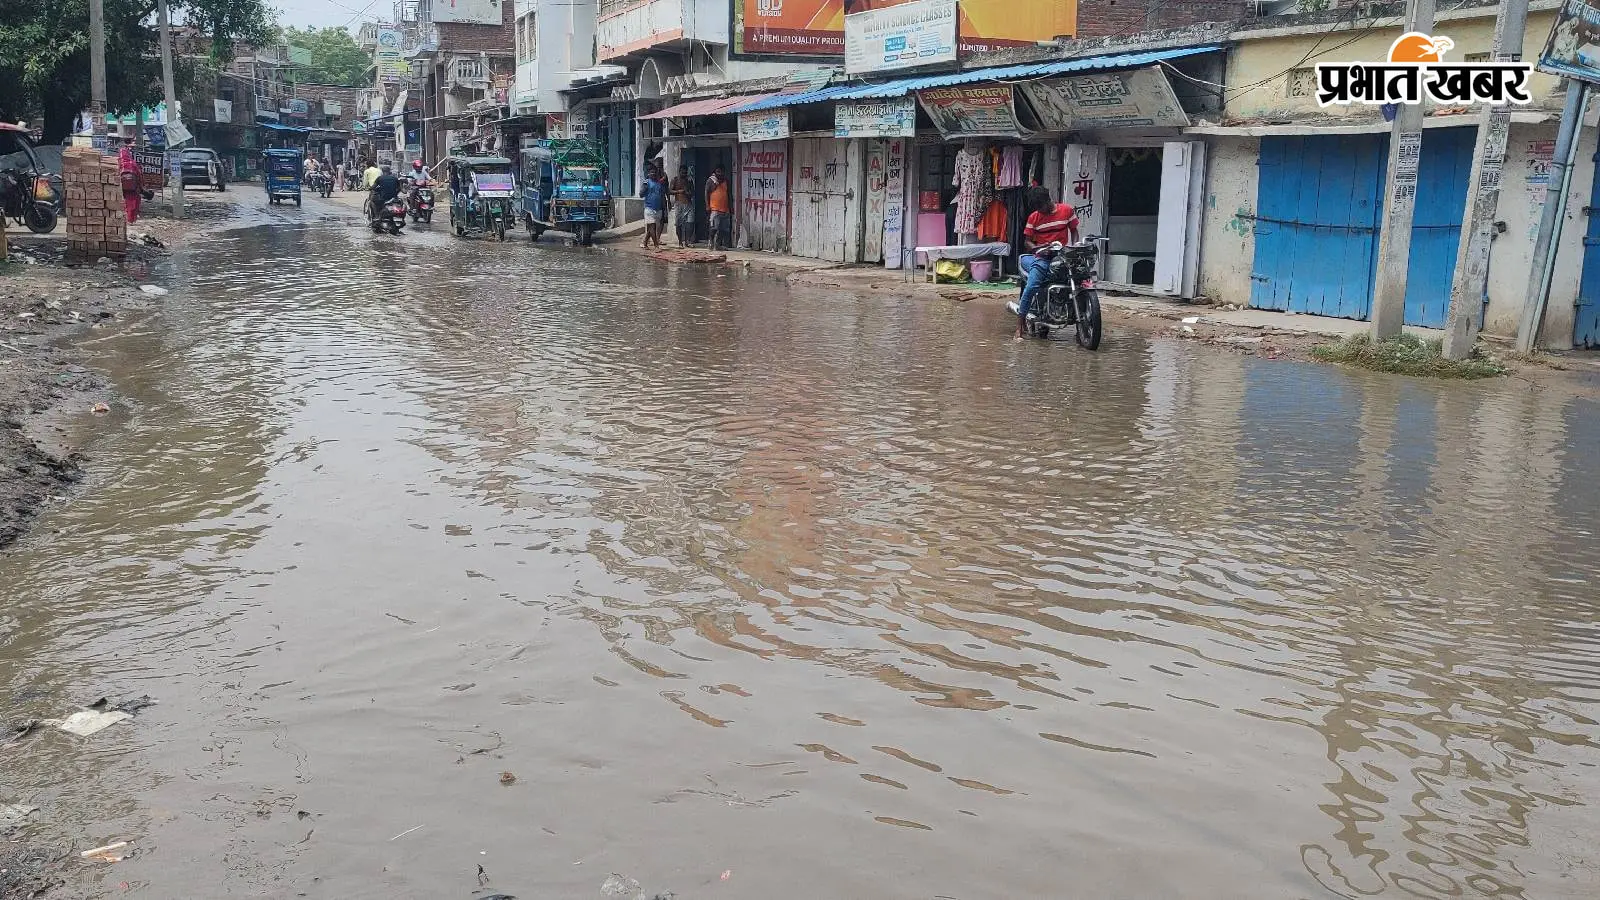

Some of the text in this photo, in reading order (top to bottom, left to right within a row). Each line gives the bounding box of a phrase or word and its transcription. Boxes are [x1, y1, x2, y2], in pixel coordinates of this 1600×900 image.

[760, 34, 791, 43] PREMIUM
[791, 36, 820, 45] QUALITY
[963, 44, 988, 52] LIMITED
[1072, 170, 1093, 201] माँ
